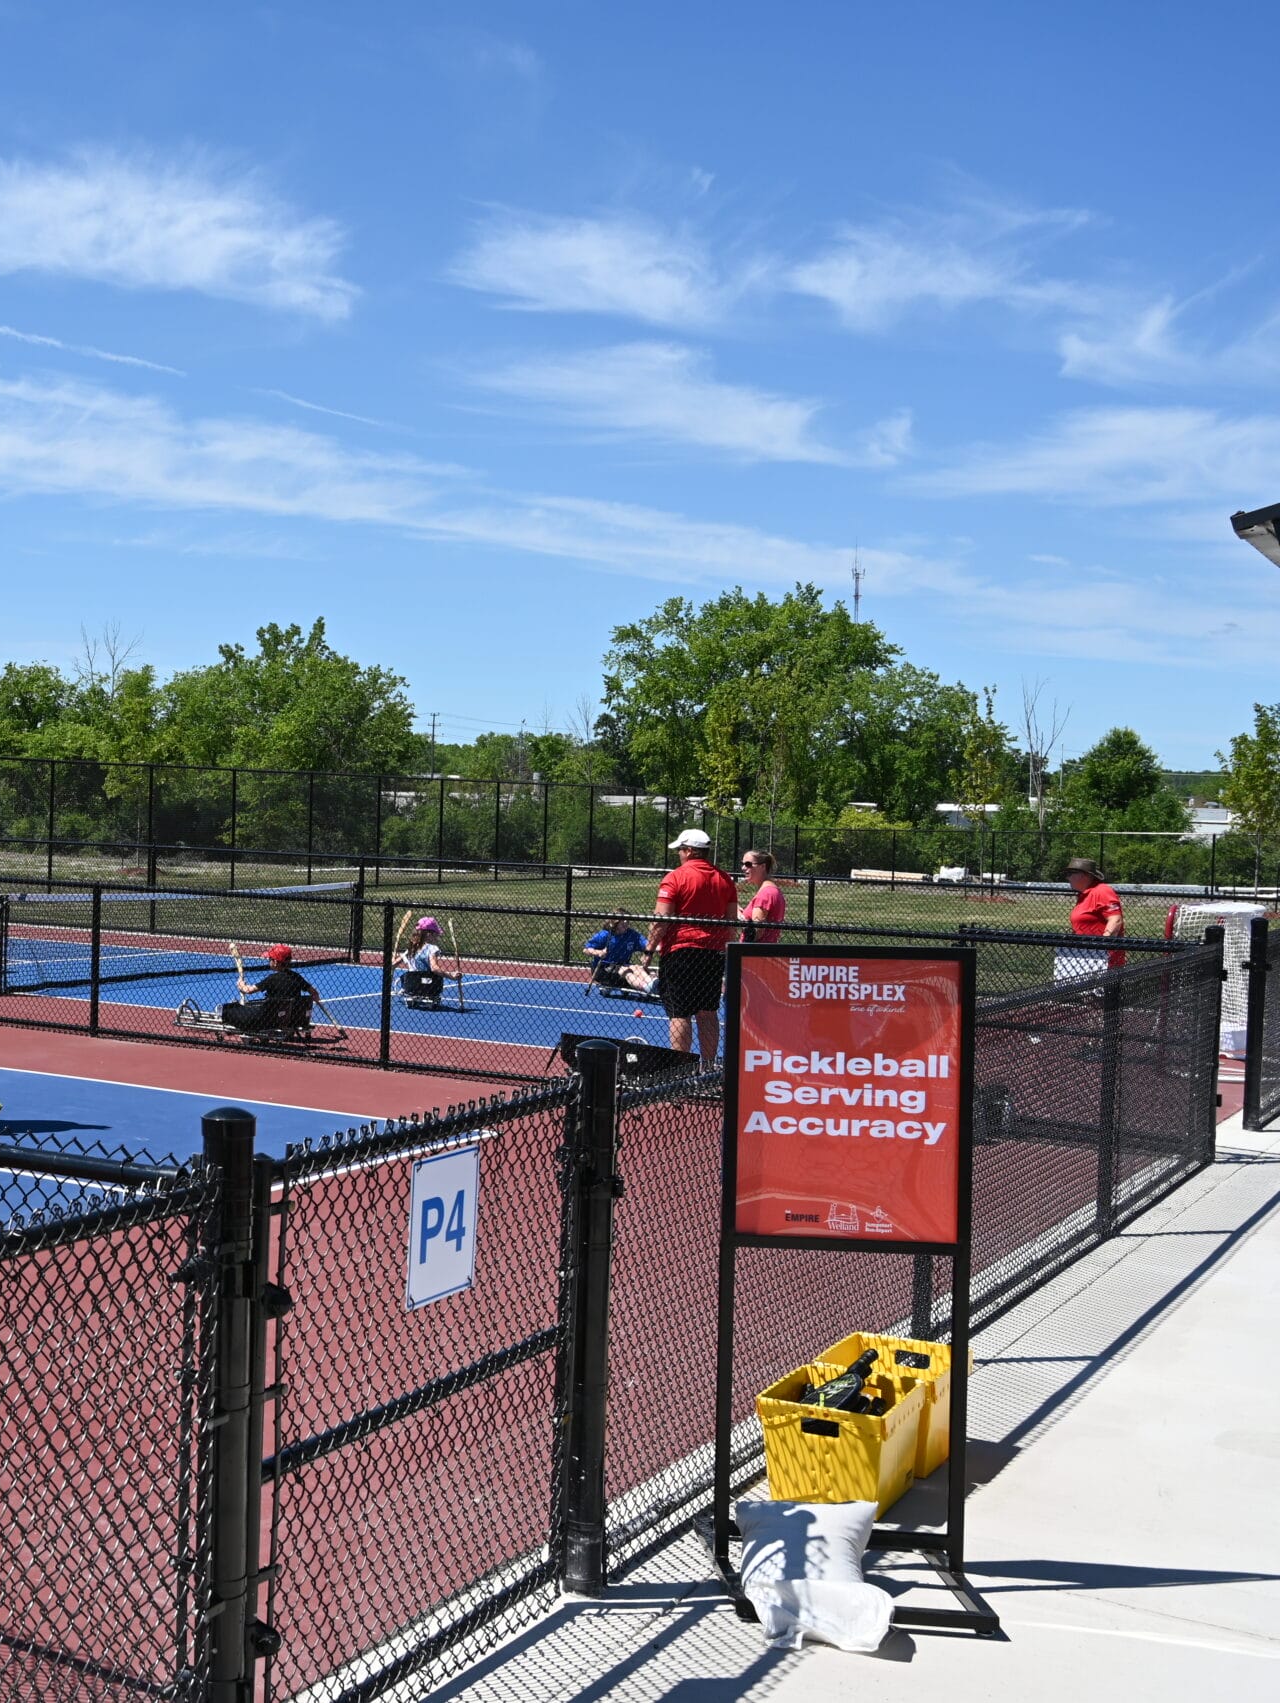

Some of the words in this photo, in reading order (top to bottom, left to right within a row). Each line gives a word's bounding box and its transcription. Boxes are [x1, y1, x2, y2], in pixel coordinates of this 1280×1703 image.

[789, 965, 859, 982] EMPIRE
[788, 982, 906, 1001] SPORTSPLEX
[744, 1050, 949, 1078] Pickleball
[764, 1080, 926, 1114] Serving
[743, 1111, 947, 1145] Accuracy
[420, 1189, 466, 1264] P4
[785, 1213, 820, 1223] EMPIRE
[829, 1221, 859, 1231] Welland
